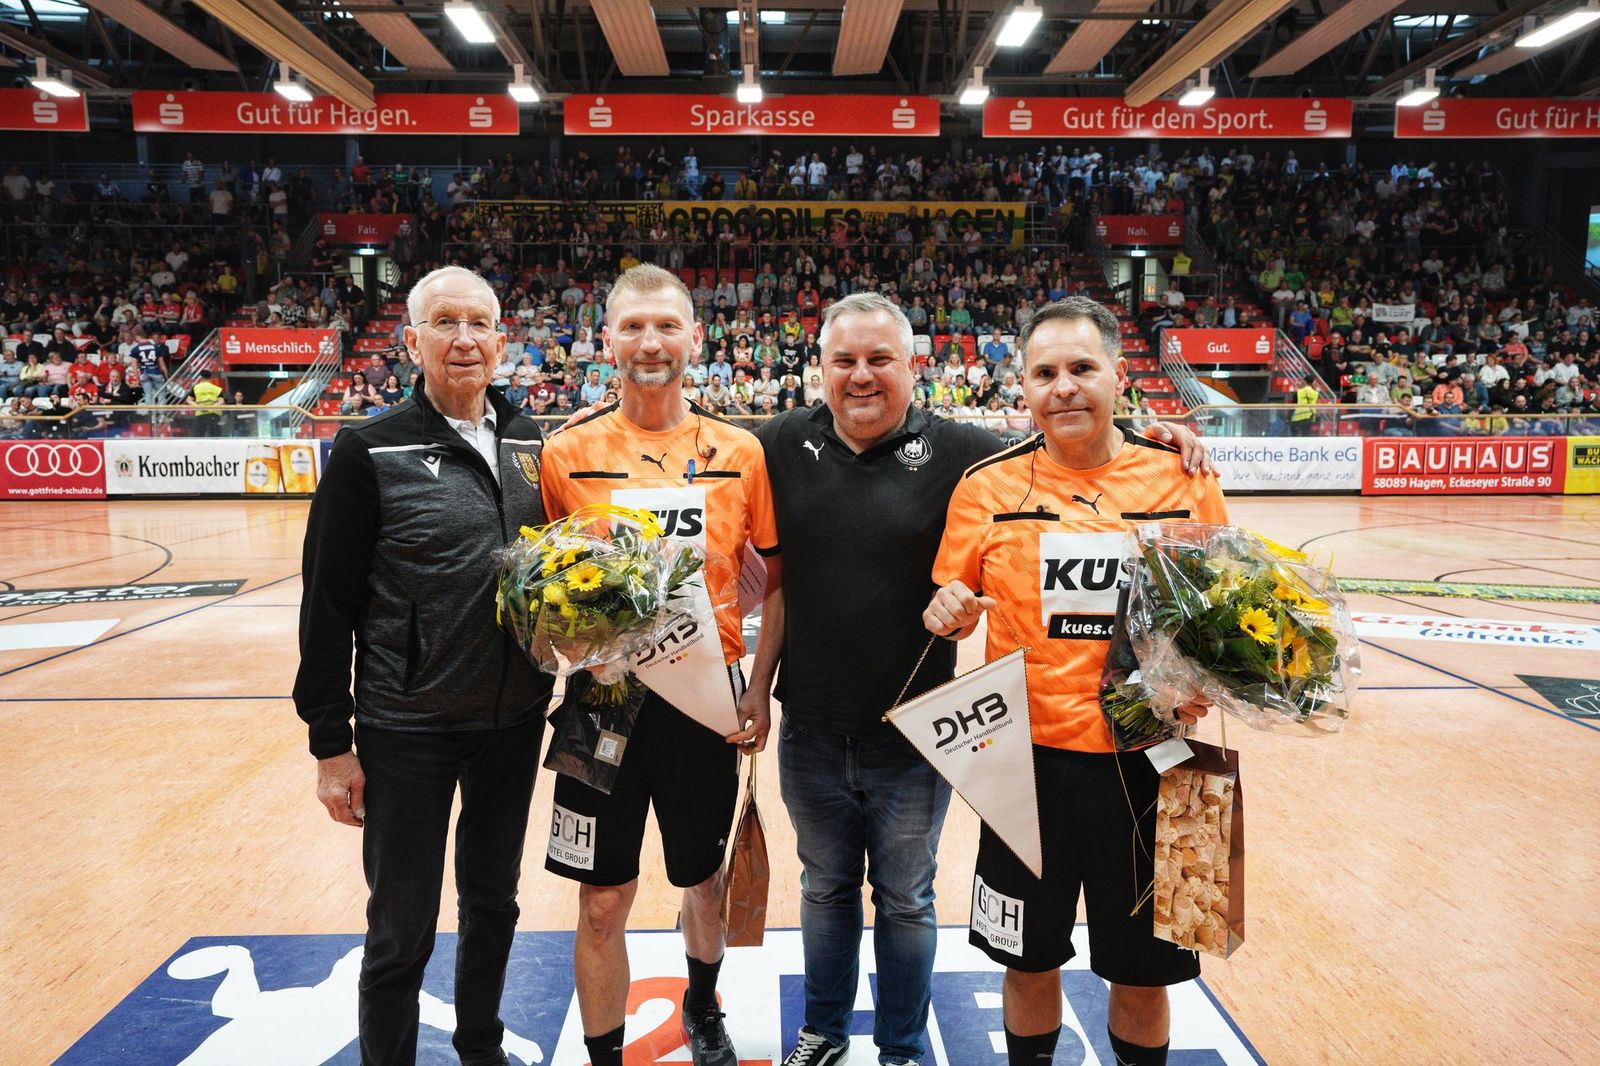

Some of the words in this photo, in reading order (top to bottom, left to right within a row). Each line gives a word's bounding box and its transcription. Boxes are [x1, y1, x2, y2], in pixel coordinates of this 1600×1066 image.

[236, 102, 282, 125] Gut
[287, 100, 323, 125] für
[330, 103, 417, 132] Hagen.
[690, 104, 816, 132] Sparkasse
[1063, 107, 1105, 130] Gut
[1111, 106, 1145, 130] für
[1151, 105, 1196, 130] den
[1202, 107, 1274, 134] Sport.
[1495, 107, 1539, 130] Gut
[1545, 106, 1580, 129] für
[357, 224, 379, 235] Fair.
[1127, 226, 1149, 236] Nah.
[139, 350, 157, 362] 14
[245, 341, 316, 354] Menschlich.
[1207, 342, 1231, 353] Gut.
[138, 454, 240, 477] Krombacher
[1289, 446, 1329, 462] Bank
[1334, 446, 1358, 462] eG
[1377, 445, 1550, 470] BAUHAUS
[8, 486, 104, 496] www.gottfried-schultz.de
[1374, 477, 1406, 488] 58089
[1409, 477, 1447, 490] Hagen,
[1449, 477, 1499, 489] Eckeseyer
[1501, 476, 1535, 488] Straße
[1537, 476, 1552, 488] 90
[648, 507, 703, 538] ÜS
[932, 692, 1008, 750] DHB
[944, 738, 973, 755] Deutscher
[973, 717, 1014, 741] Handballbund
[551, 809, 591, 848] GCH
[564, 851, 590, 865] GROUP
[978, 883, 1019, 932] GCH
[990, 933, 1019, 949] GROUP
